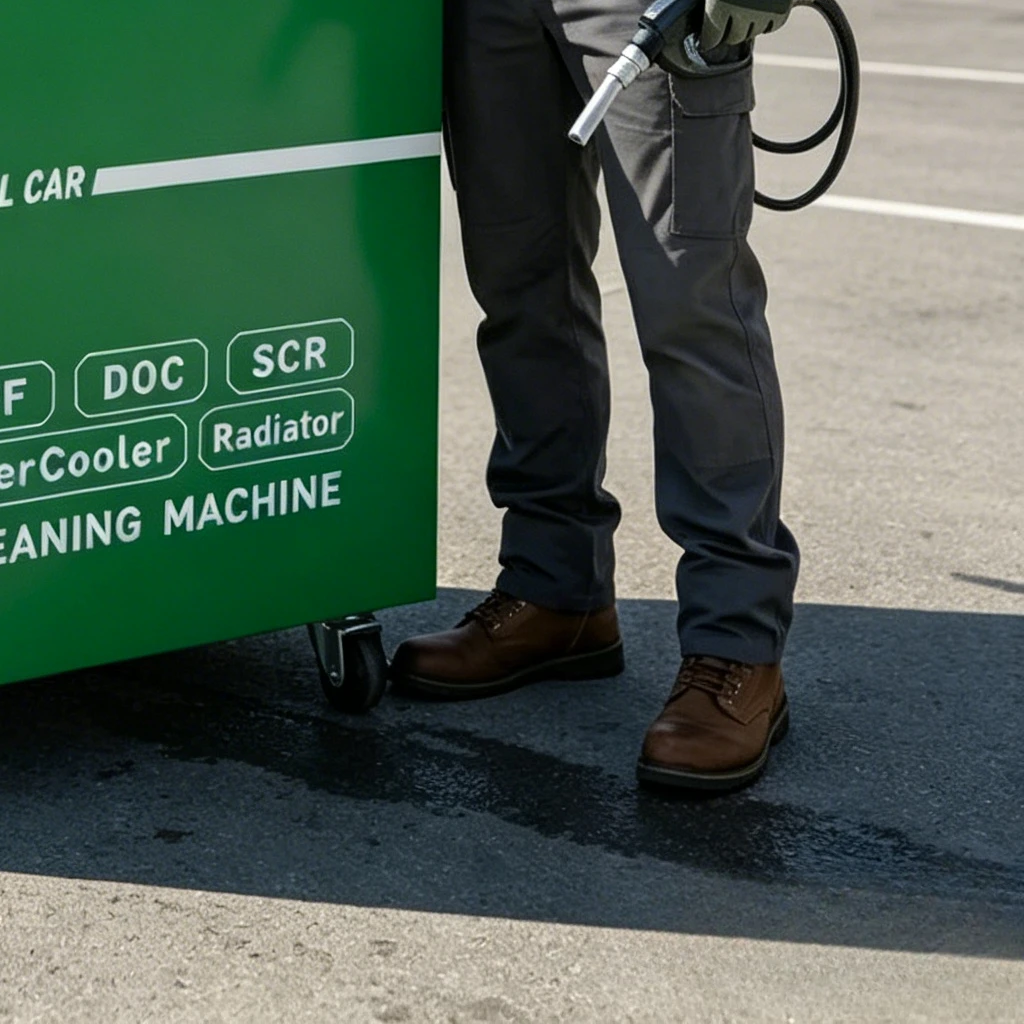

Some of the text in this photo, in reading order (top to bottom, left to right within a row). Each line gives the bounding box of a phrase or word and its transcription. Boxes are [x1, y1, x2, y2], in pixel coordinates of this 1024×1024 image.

[23, 165, 86, 204] CAR
[103, 355, 184, 400] DOC
[252, 336, 327, 378] SCR
[213, 409, 345, 453] Radiator
[164, 470, 342, 535] MACHINE
